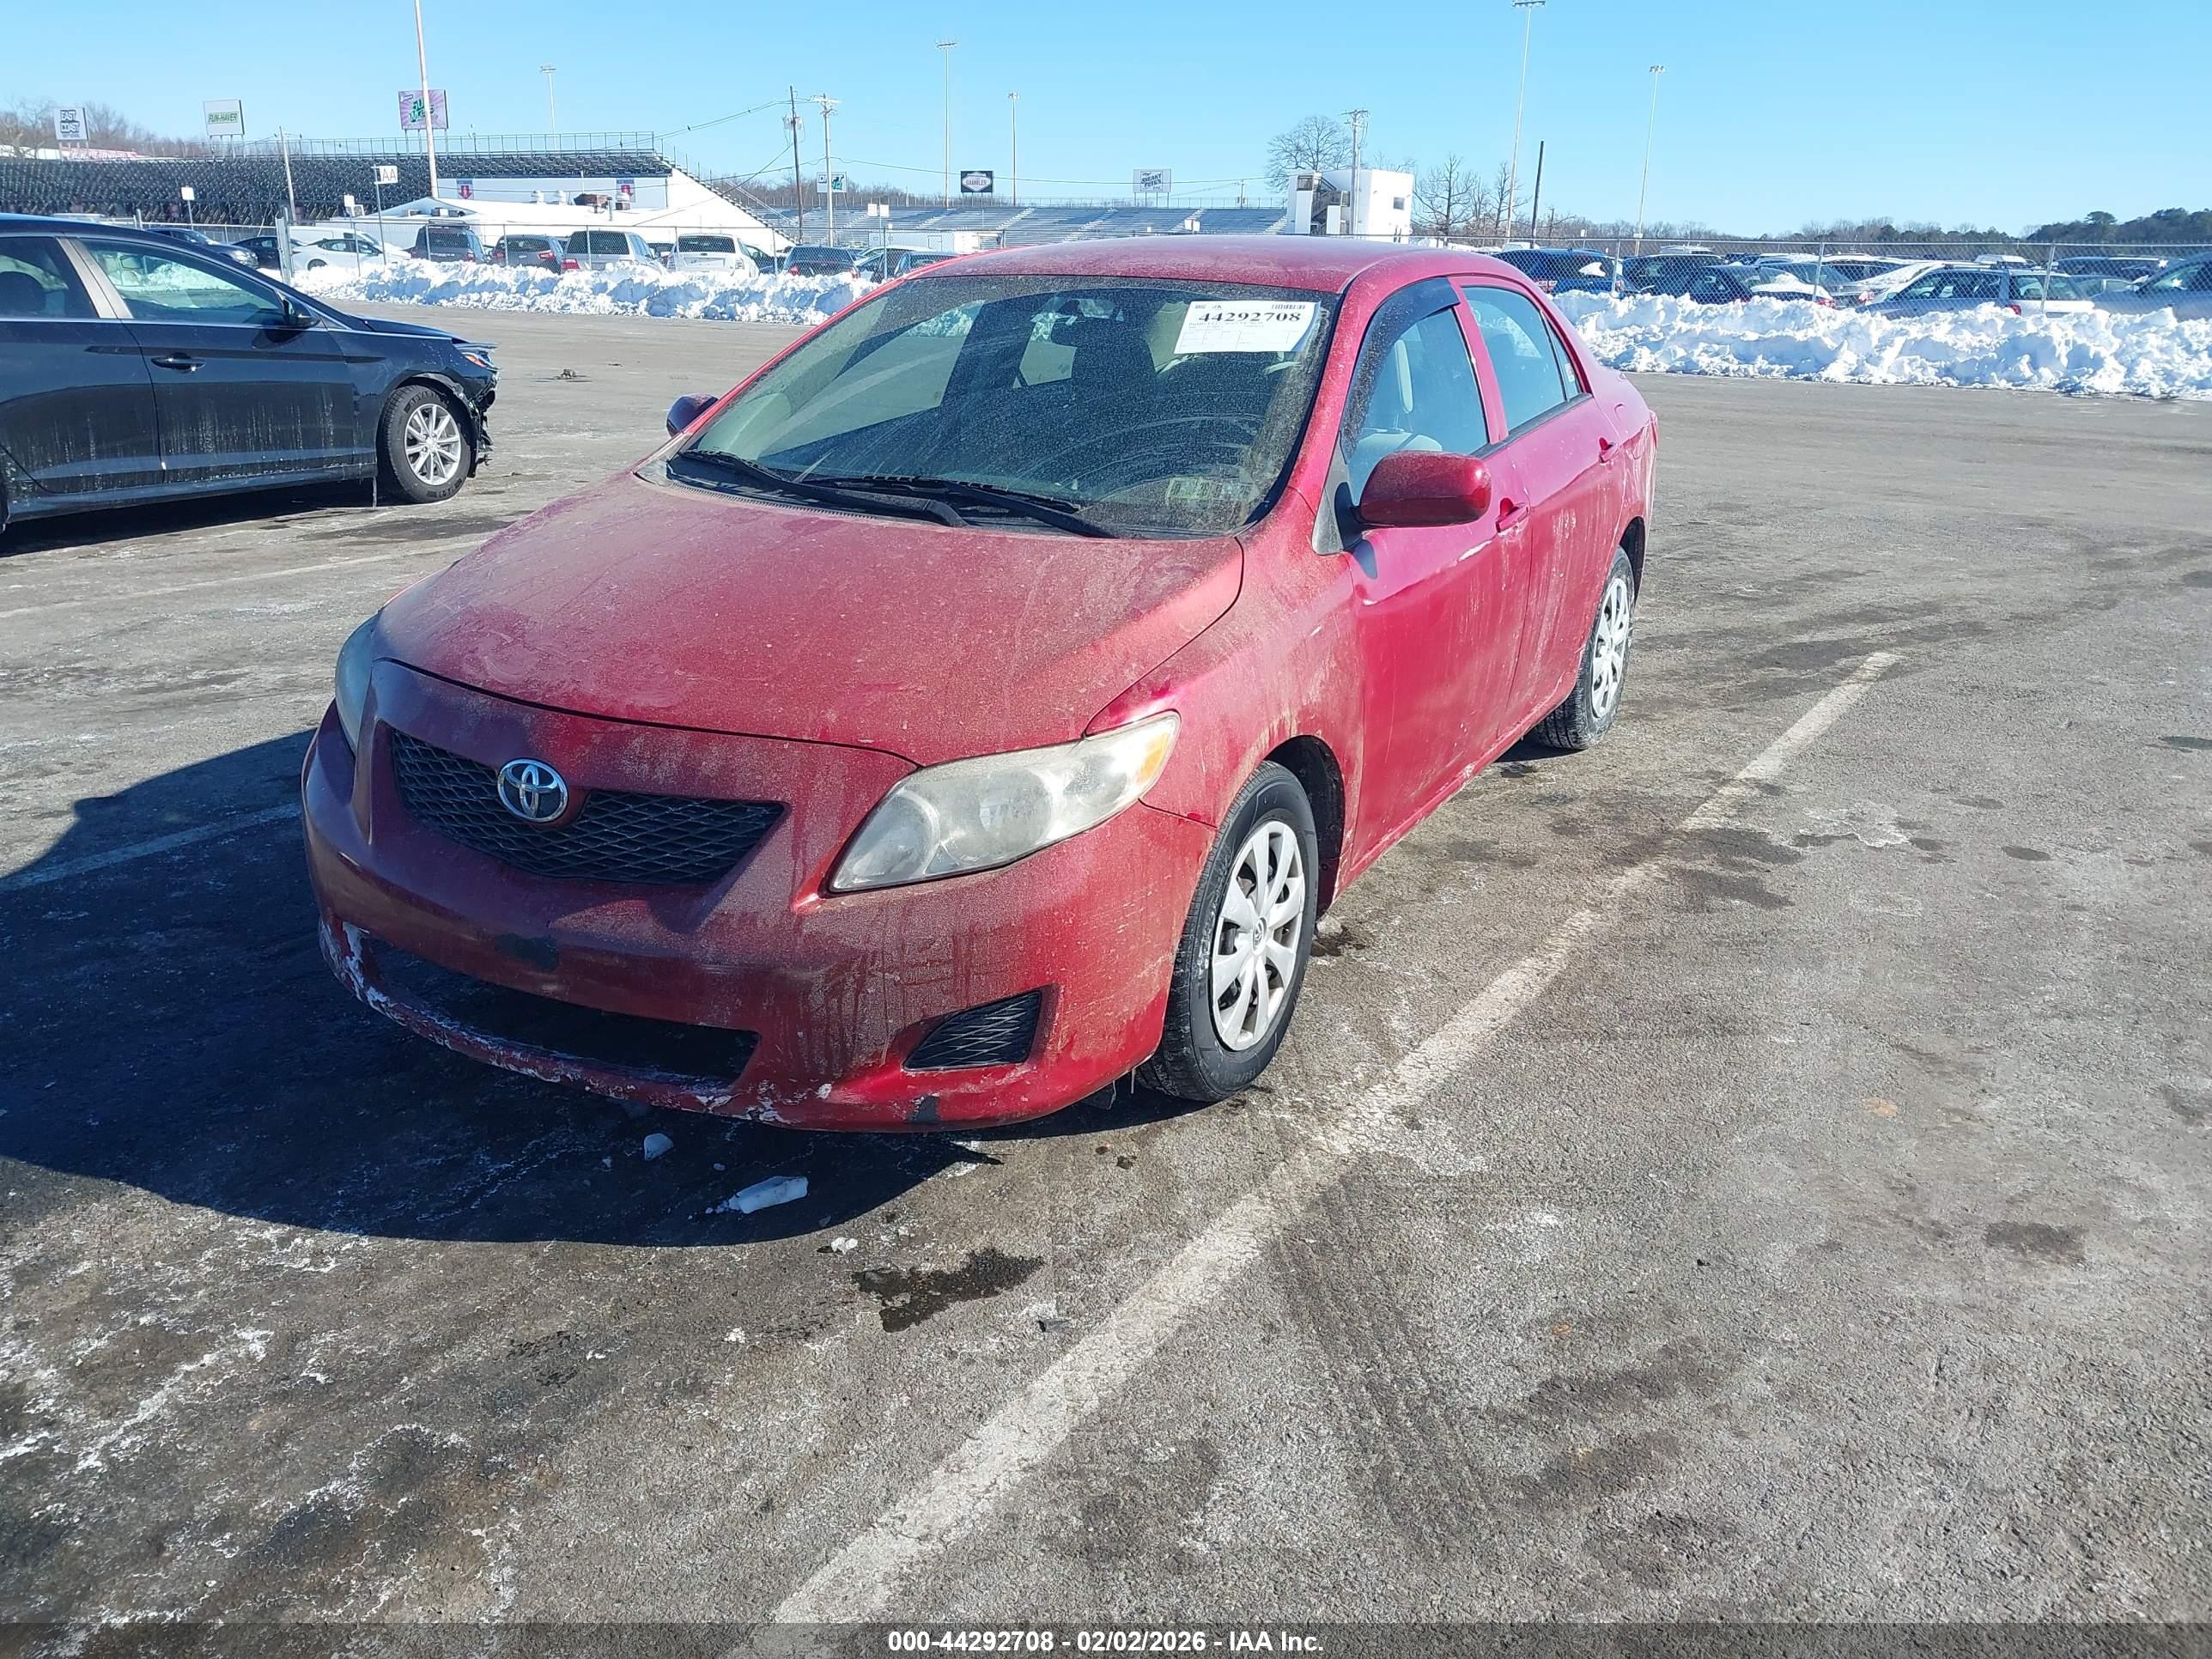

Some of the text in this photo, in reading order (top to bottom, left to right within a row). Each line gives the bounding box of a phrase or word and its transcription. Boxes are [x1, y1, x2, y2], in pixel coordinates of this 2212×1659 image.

[60, 109, 76, 121] EAST
[382, 168, 397, 180] AA
[1199, 312, 1302, 322] 44292708
